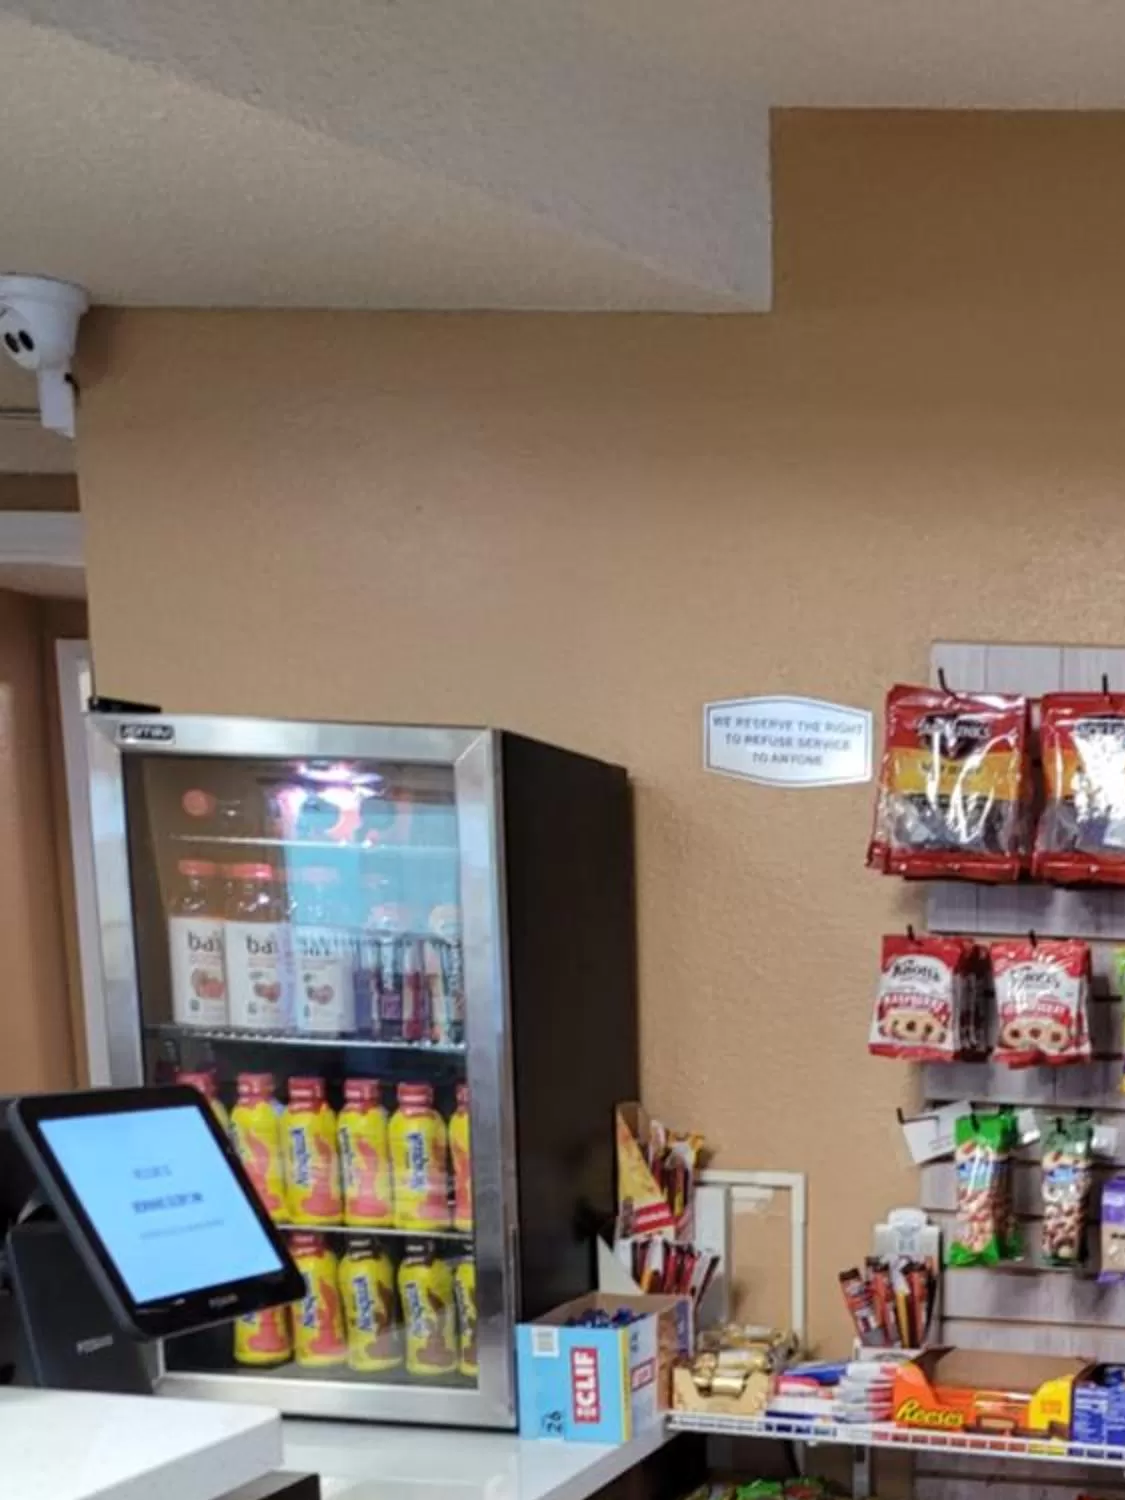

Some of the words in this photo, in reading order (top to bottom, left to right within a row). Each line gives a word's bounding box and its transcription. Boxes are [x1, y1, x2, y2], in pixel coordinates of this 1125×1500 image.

[712, 715, 732, 729] WE
[735, 716, 793, 732] RESERVE
[798, 719, 820, 733] THE
[825, 720, 863, 736] RIGHT
[725, 732, 741, 746] TO
[743, 734, 793, 748] REFUSE
[797, 736, 851, 751] SERVICE
[752, 752, 769, 764] TO
[771, 753, 823, 766] ANYONE
[573, 1350, 597, 1407] CLIF
